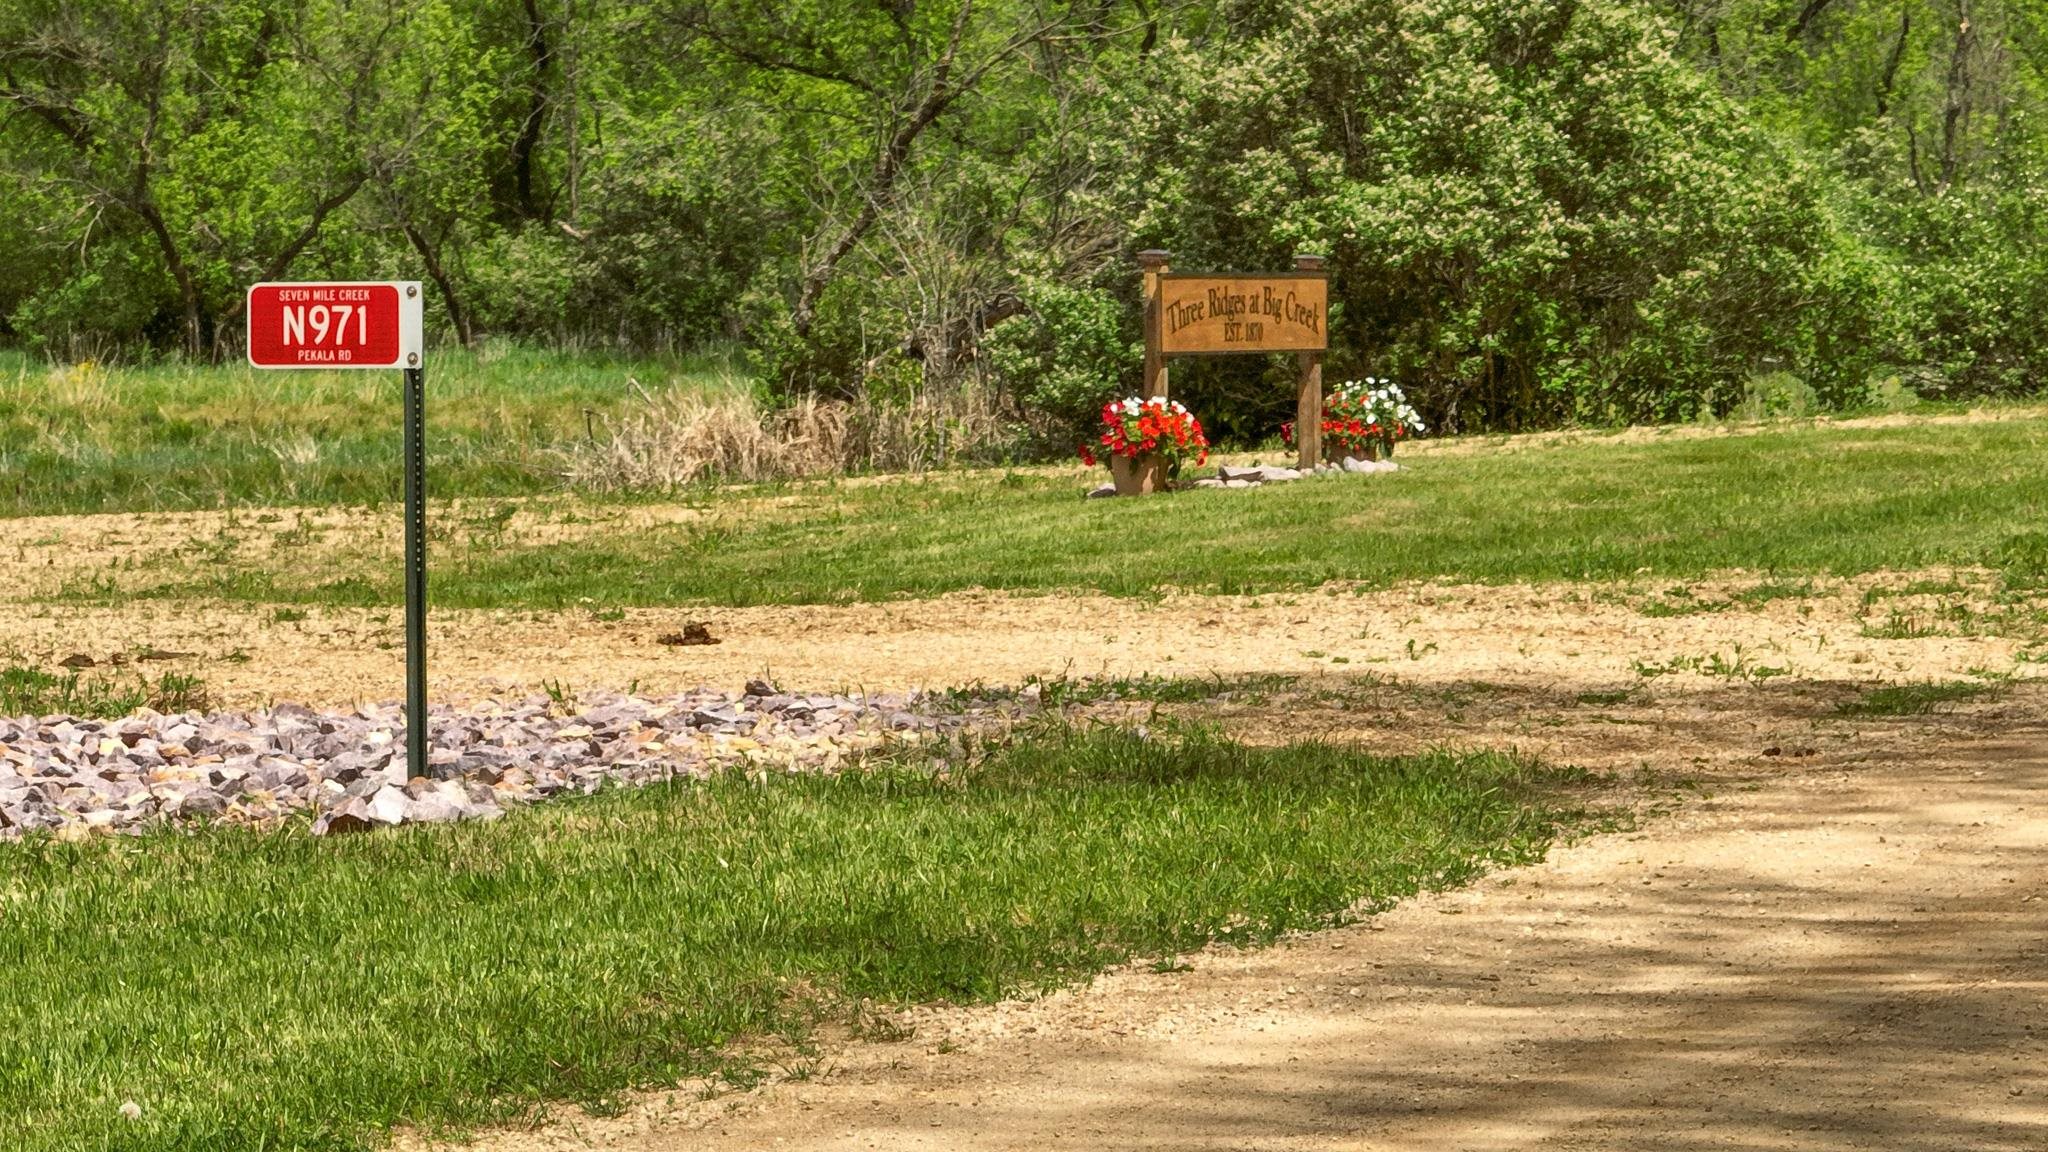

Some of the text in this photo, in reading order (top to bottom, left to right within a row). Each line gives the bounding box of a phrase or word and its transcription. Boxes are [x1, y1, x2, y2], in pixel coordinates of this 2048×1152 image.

[279, 289, 370, 302] SEVEN MILE CREEK
[1166, 285, 1319, 335] Three Ridges at Big Creek
[283, 304, 367, 346] N971
[1224, 322, 1244, 342] EST.
[297, 349, 352, 361] PEKALA RD
